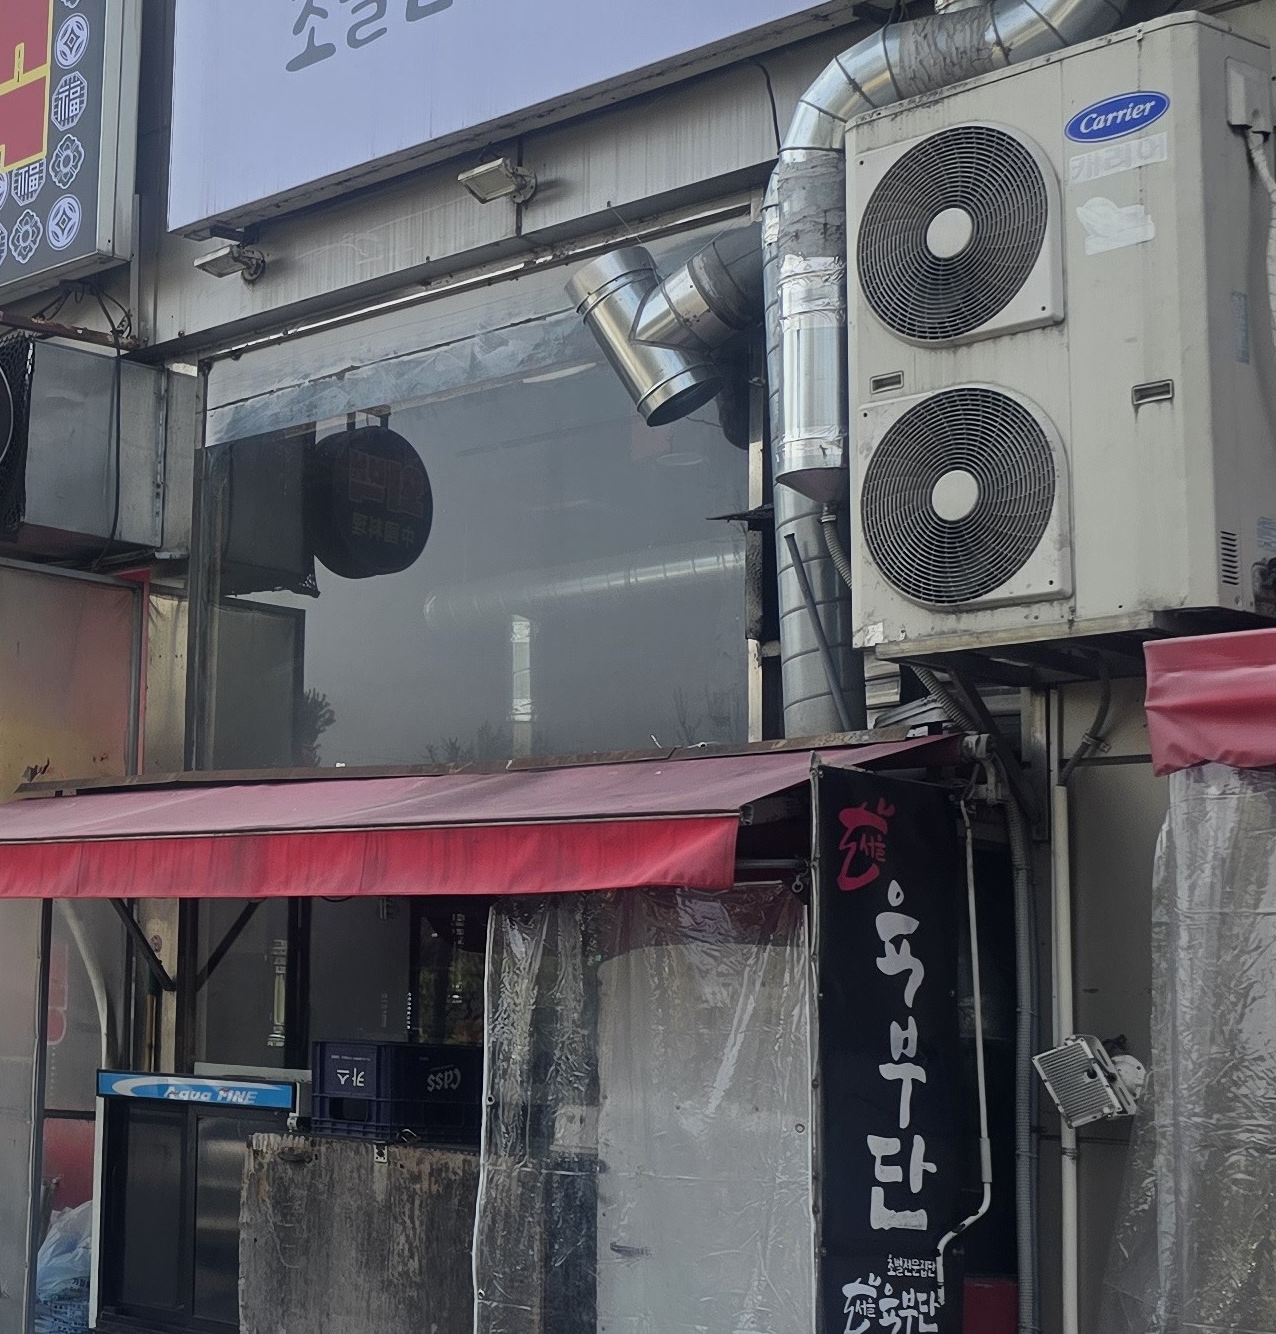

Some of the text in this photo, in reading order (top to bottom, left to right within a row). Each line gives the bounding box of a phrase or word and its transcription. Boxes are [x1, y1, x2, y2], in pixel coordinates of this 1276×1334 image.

[1079, 100, 1156, 134] Carrier
[866, 879, 938, 1231] 육부단
[164, 1086, 212, 1101] Aqua
